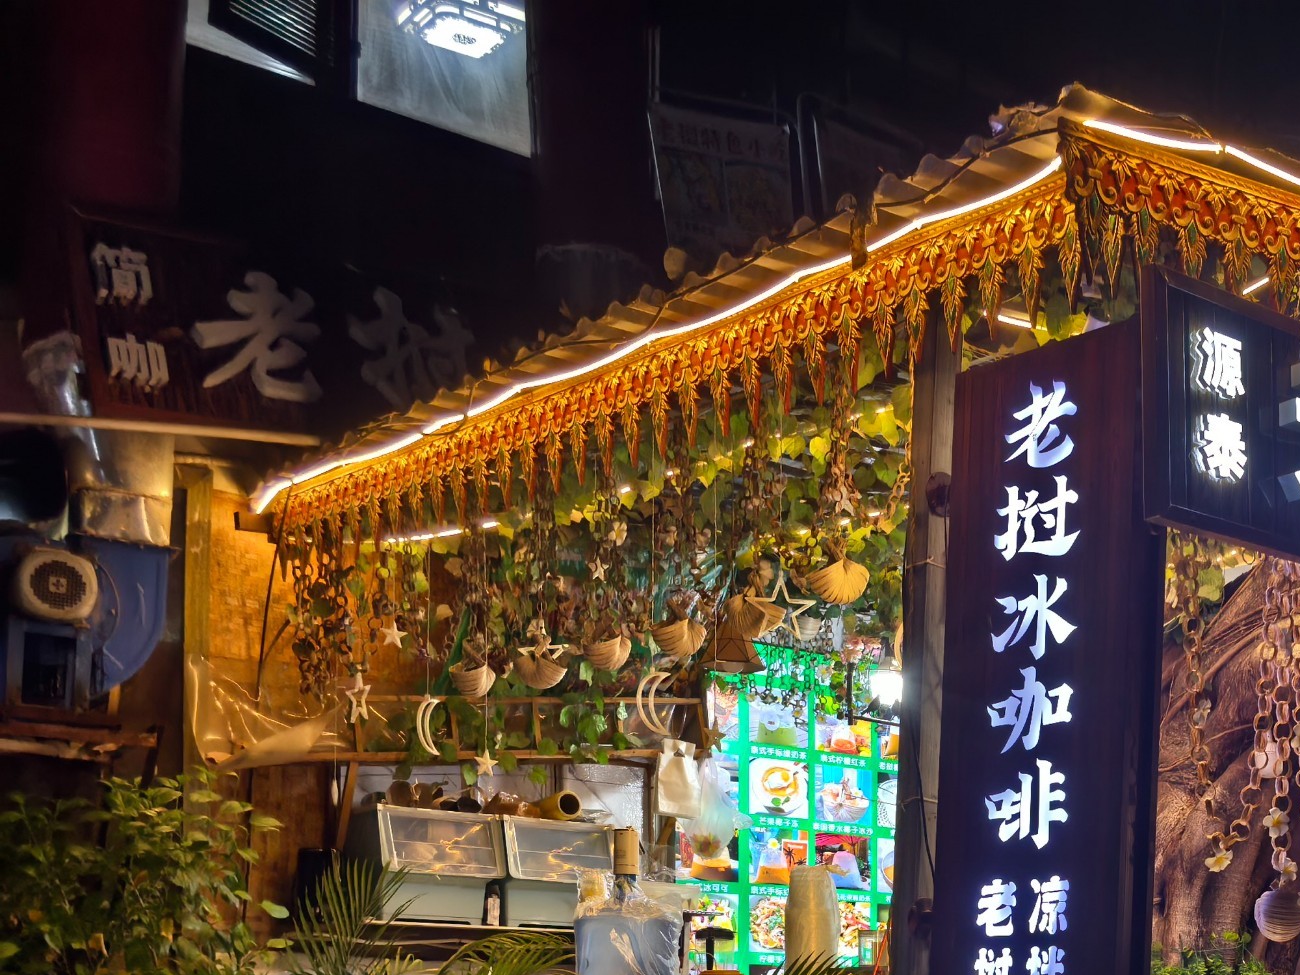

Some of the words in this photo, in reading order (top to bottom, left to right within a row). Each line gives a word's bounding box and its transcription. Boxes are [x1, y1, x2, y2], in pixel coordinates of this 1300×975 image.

[984, 379, 1081, 850] 老挝冰咖啡
